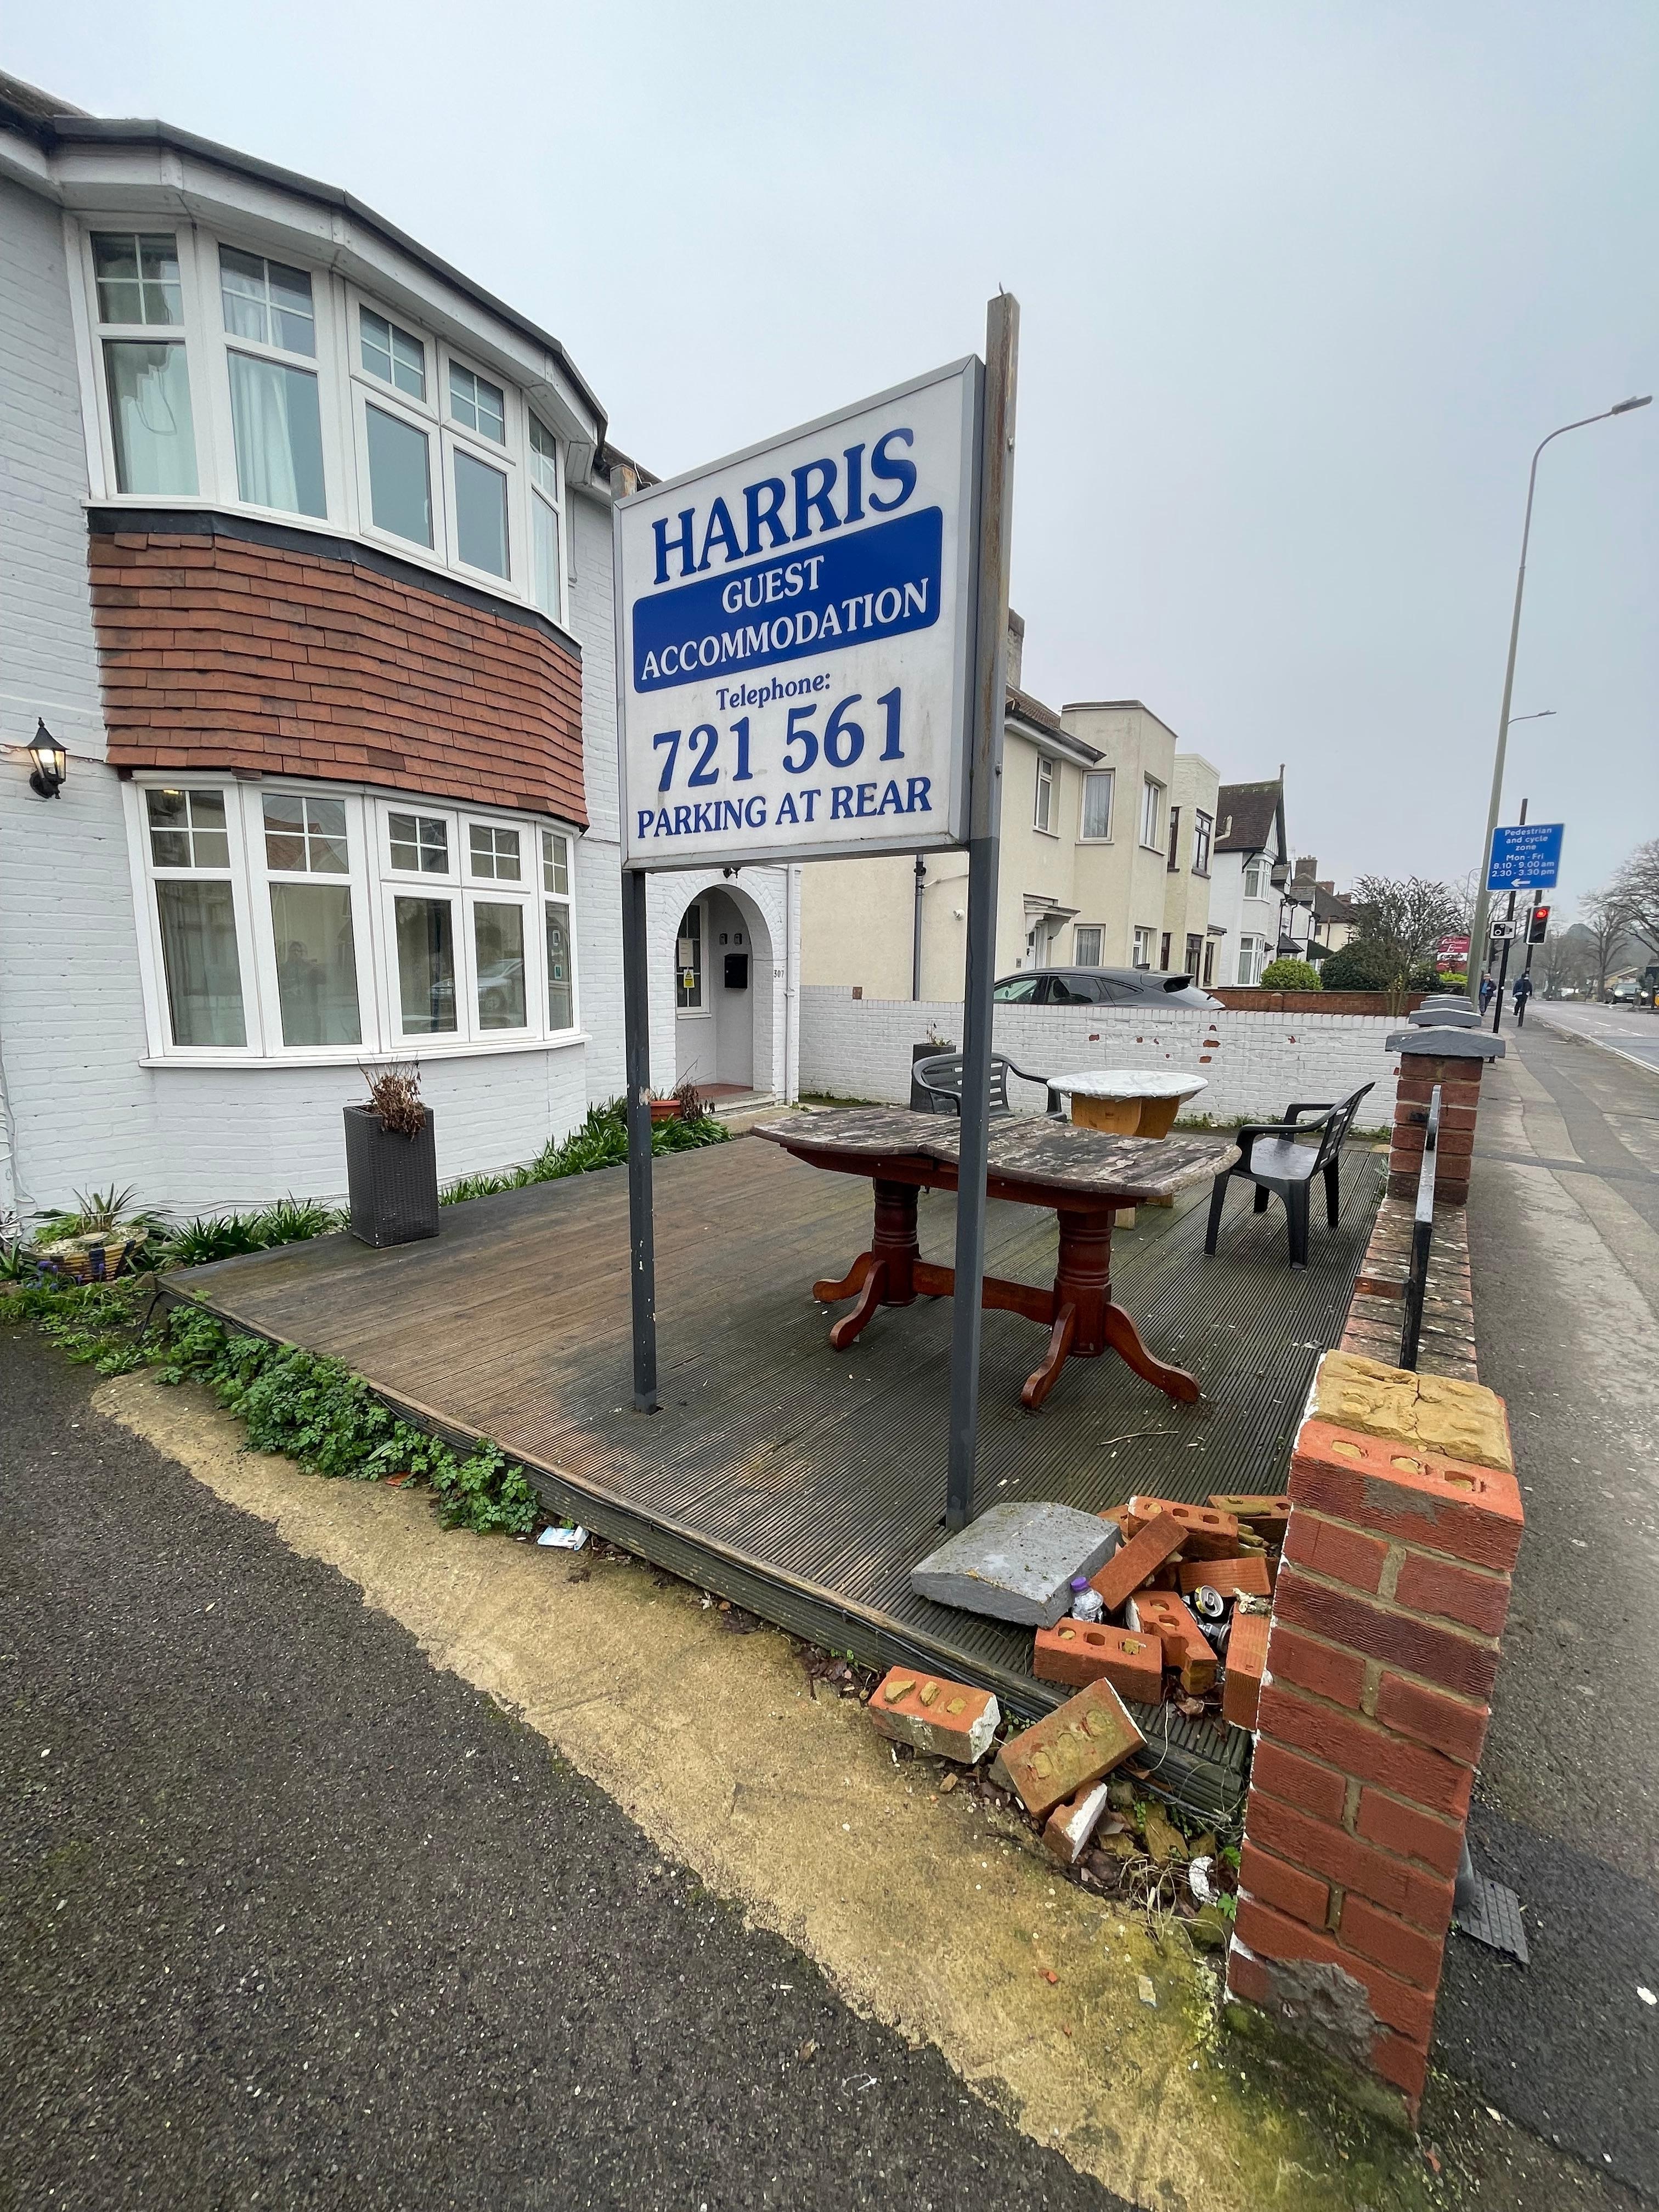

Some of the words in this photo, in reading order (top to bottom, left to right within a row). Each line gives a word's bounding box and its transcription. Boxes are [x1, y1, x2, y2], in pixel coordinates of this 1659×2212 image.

[652, 428, 917, 585] HARRIS
[721, 555, 825, 614] GUEST
[641, 578, 928, 681] ACCOMMODATION
[716, 673, 830, 710] Telephone:
[653, 715, 753, 792] 721
[782, 687, 905, 774] 561
[637, 795, 766, 839] PARKING
[776, 790, 821, 825] AT
[830, 777, 932, 820] REAR
[1505, 828, 1552, 836] Pedestrian
[1525, 835, 1548, 843] cycle
[774, 969, 784, 978] 307
